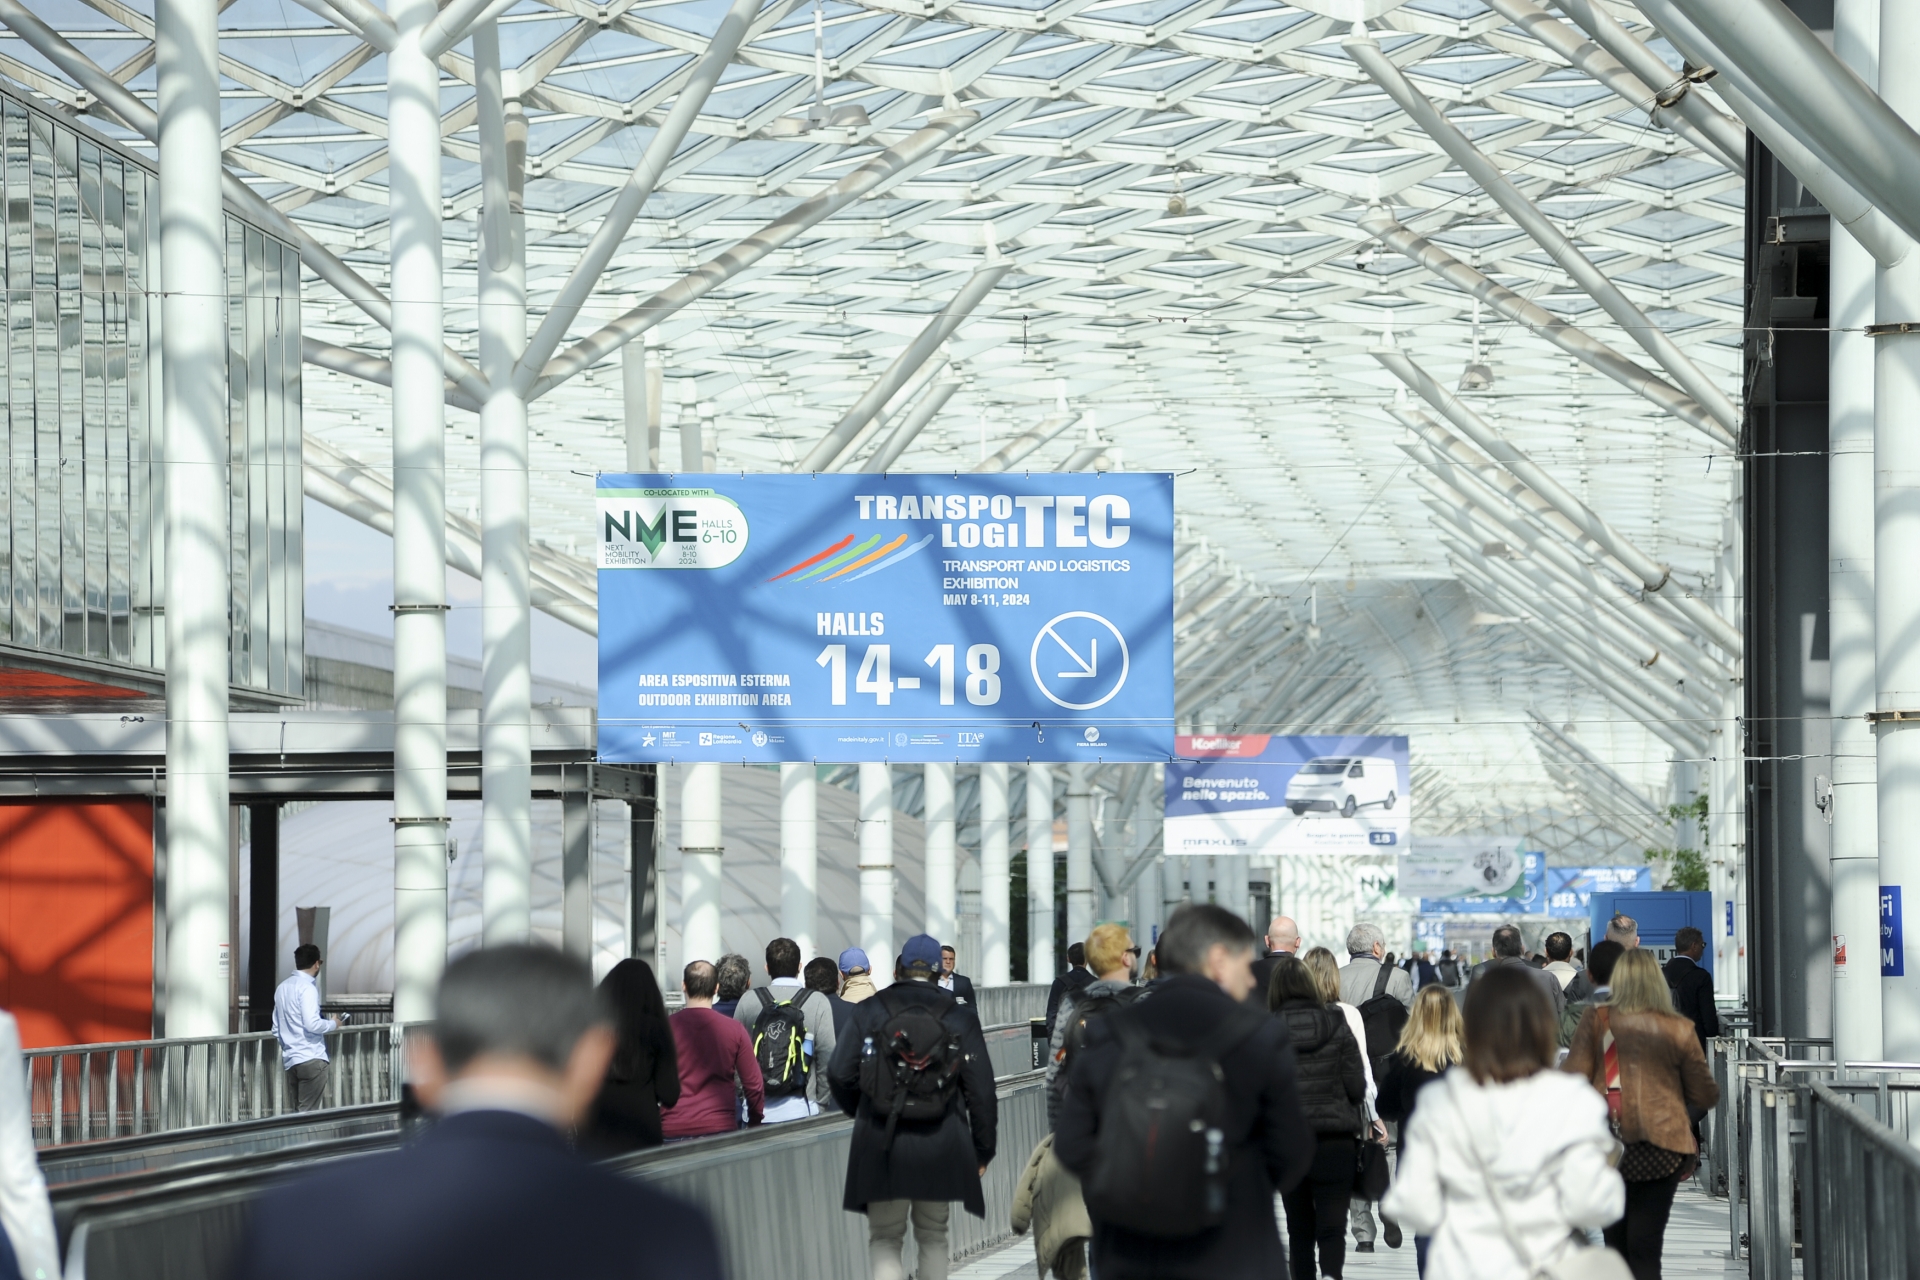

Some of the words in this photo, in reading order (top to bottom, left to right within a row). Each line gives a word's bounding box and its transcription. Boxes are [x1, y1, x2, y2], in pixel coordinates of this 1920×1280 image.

[854, 494, 1013, 520] TRANSPO
[605, 507, 697, 544] NME
[701, 519, 733, 529] HALLS
[1015, 494, 1131, 549] TEC
[702, 529, 737, 544] 6-10
[942, 522, 1018, 548] LOGI
[943, 560, 1025, 572] TRANSPORT
[1027, 560, 1057, 572] AND
[1059, 560, 1131, 572] LOGISTICS
[943, 577, 1019, 589] EXHIBITION
[943, 594, 968, 606] MAY
[970, 594, 1000, 608] 8-11,
[1002, 594, 1031, 606] 2024
[816, 612, 885, 636] HALLS
[639, 674, 669, 687] AREA
[672, 674, 737, 687] ESPOSITIVA
[740, 674, 791, 687] ESTERNA
[815, 643, 1002, 706] 14-18
[639, 693, 691, 706] OUTDOOR
[694, 693, 758, 706] EXHIBITION
[761, 693, 792, 706] AREA
[662, 731, 676, 739] MIT
[1182, 776, 1259, 788] Benvenuto
[1182, 788, 1217, 800] nello
[1220, 789, 1270, 802] spazio.
[1373, 833, 1391, 844] 18
[1884, 924, 1893, 938] by
[1658, 949, 1667, 961] IL
